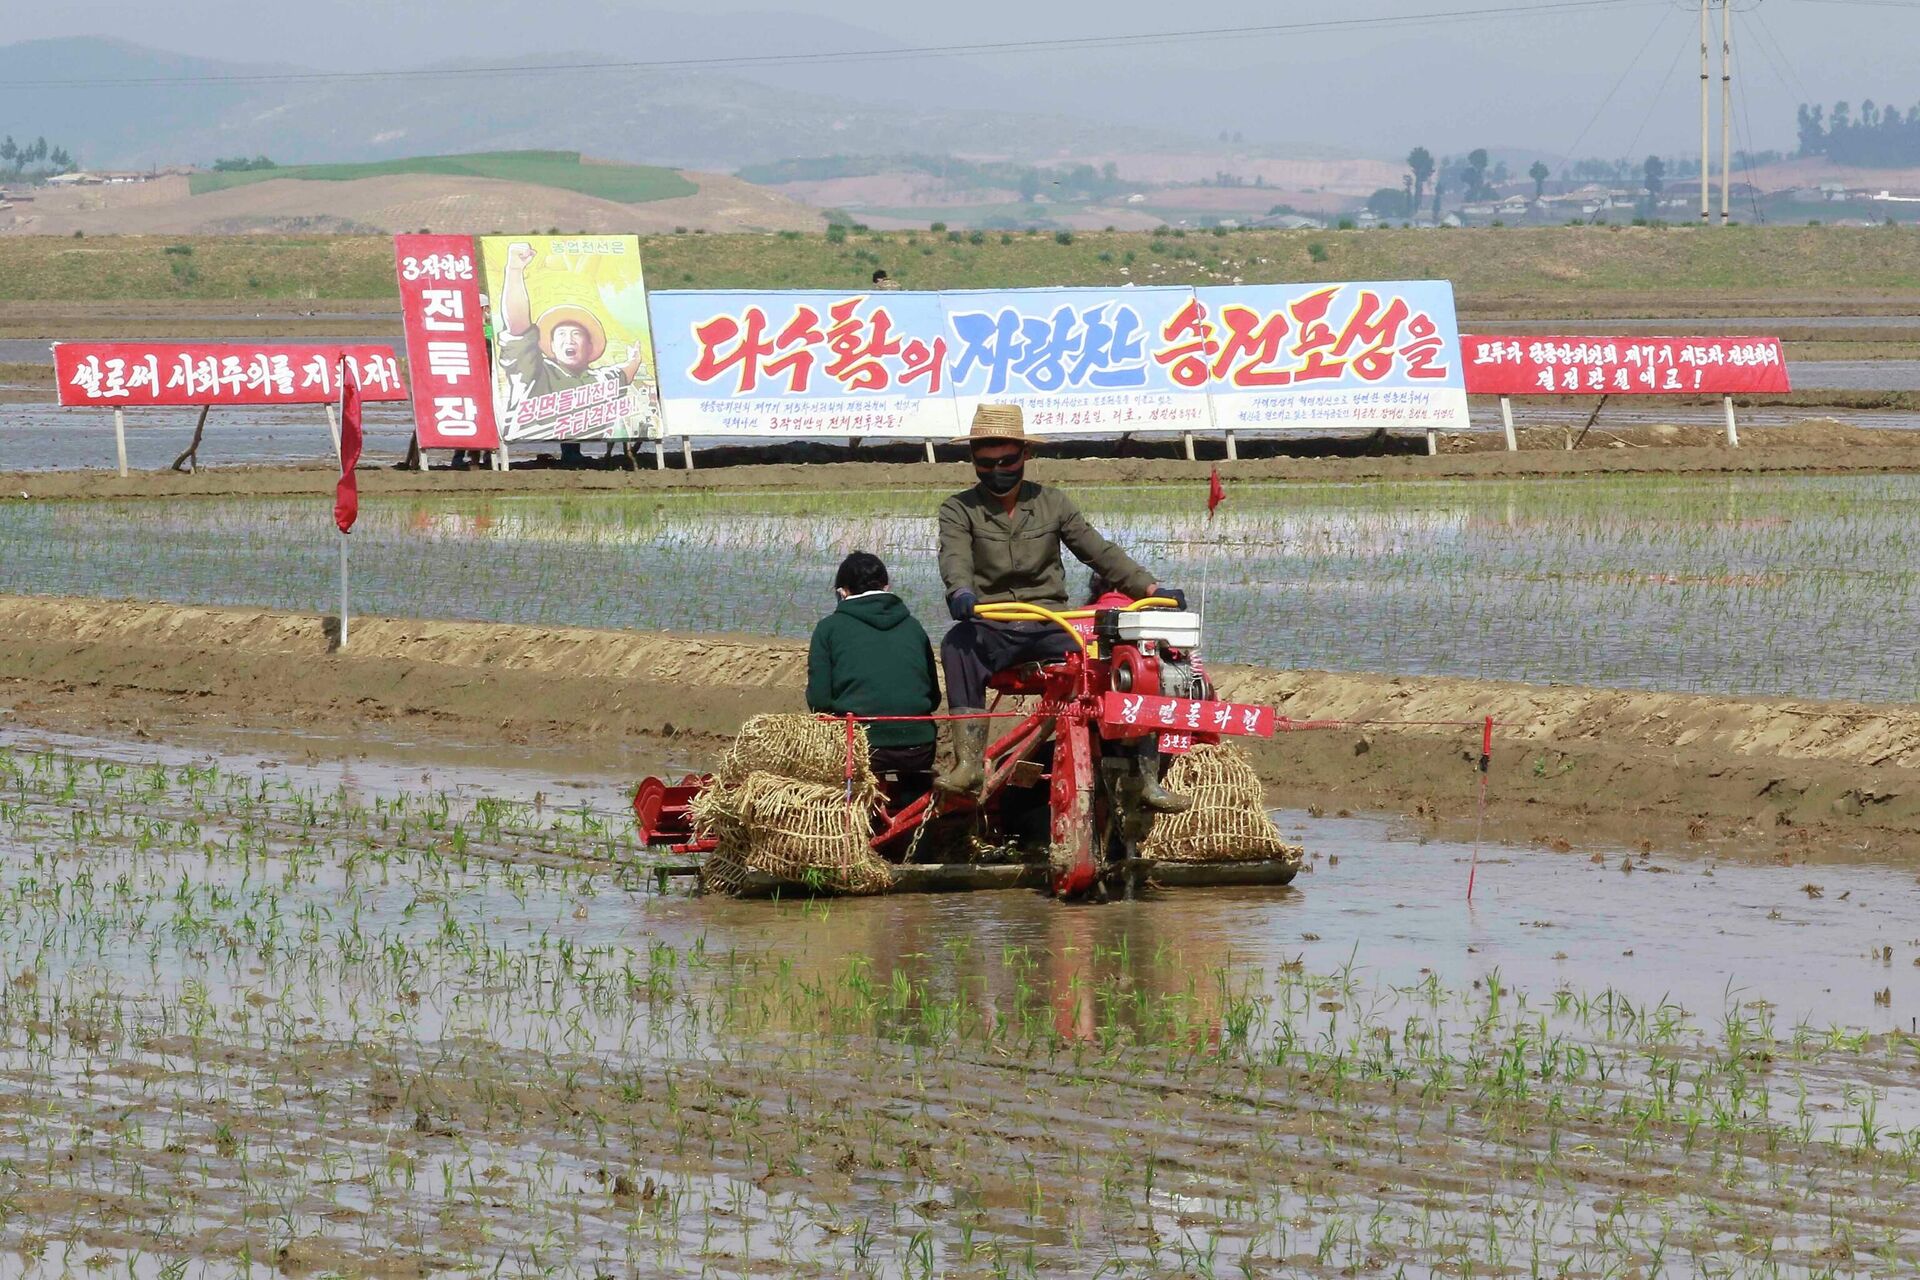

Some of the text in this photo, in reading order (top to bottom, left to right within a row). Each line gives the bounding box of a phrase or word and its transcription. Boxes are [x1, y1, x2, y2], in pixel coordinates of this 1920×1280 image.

[552, 241, 625, 254] 농업전선은
[402, 254, 474, 281] 3작업반
[690, 286, 1449, 394] 다수확의 자랑찬 승전포성을
[1529, 342, 1617, 366] 당중앙위원회
[1624, 344, 1674, 367] 제7기
[1679, 345, 1724, 367] 제5차
[1727, 343, 1779, 367] 전원회의
[70, 353, 159, 398] 쌀로써
[166, 352, 295, 397] 사회주의를
[421, 288, 478, 437] 전투장
[515, 378, 619, 425] 정면돌파전의
[1121, 695, 1261, 732] 정면돌파전
[1162, 733, 1188, 748] 3분조
